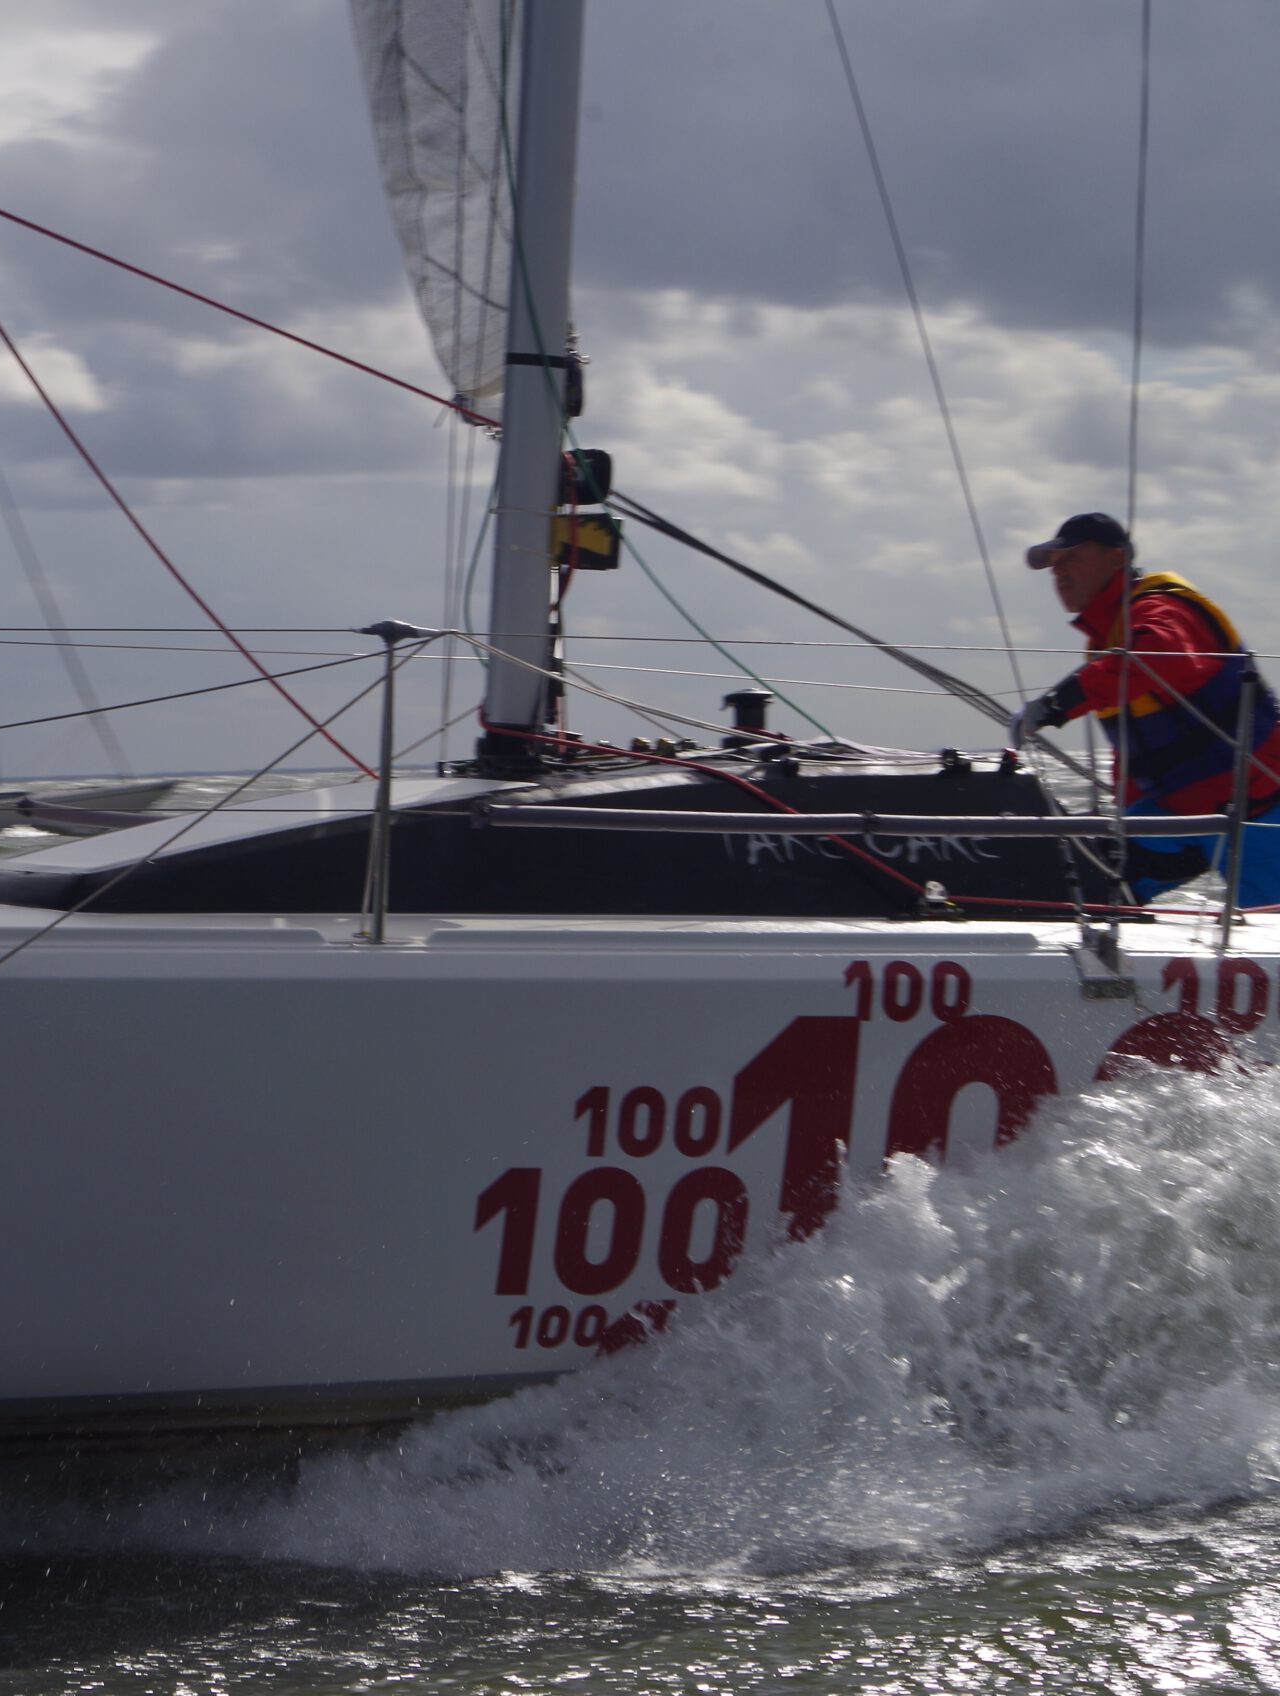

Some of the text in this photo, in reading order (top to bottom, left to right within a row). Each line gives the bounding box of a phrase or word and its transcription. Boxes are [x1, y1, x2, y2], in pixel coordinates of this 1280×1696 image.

[843, 960, 973, 1023] 100
[1161, 957, 1280, 1035] 10
[574, 1085, 724, 1158] 100
[725, 1012, 1240, 1244] 10
[473, 1166, 750, 1296] 100
[508, 1304, 608, 1349] 100
